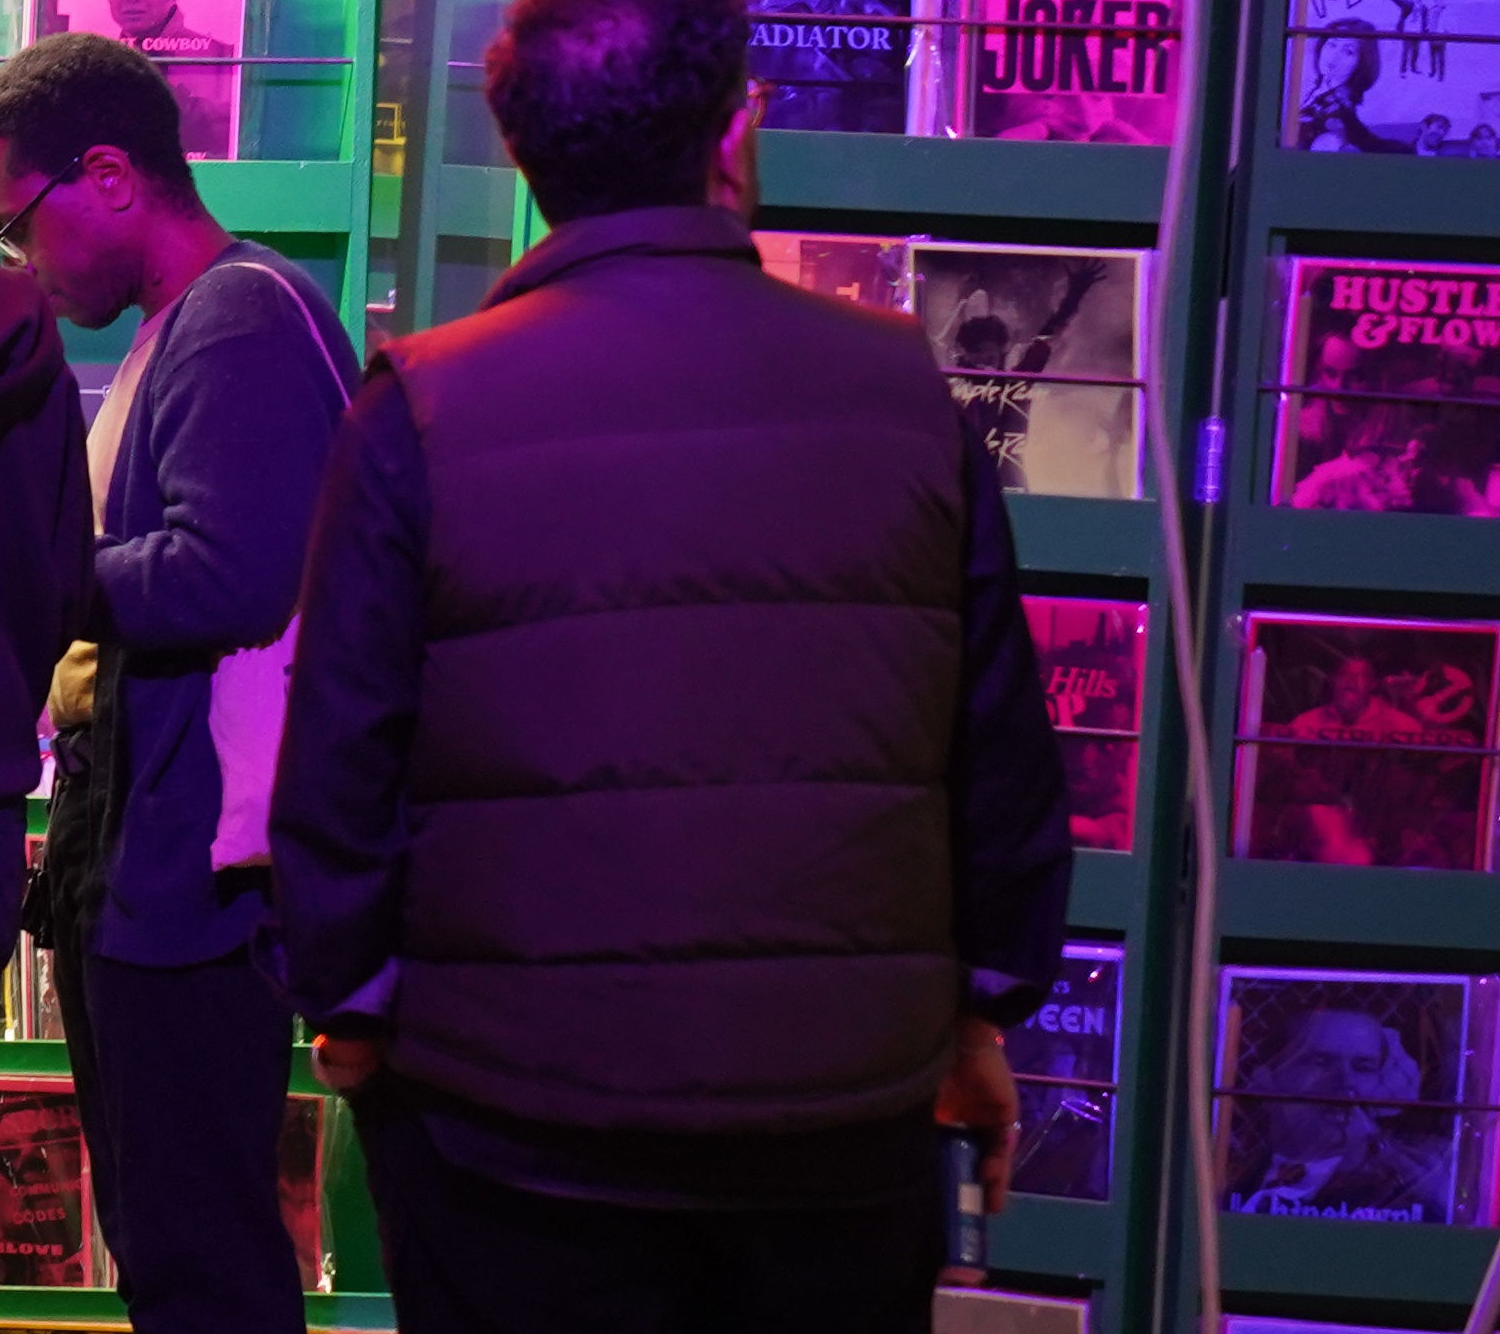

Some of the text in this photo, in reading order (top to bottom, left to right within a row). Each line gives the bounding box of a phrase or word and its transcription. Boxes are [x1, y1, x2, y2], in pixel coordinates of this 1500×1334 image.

[142, 36, 211, 52] COWBOY
[749, 23, 893, 51] ADIATOR
[1351, 312, 1500, 349] & FLOW
[1046, 665, 1118, 700] Hills
